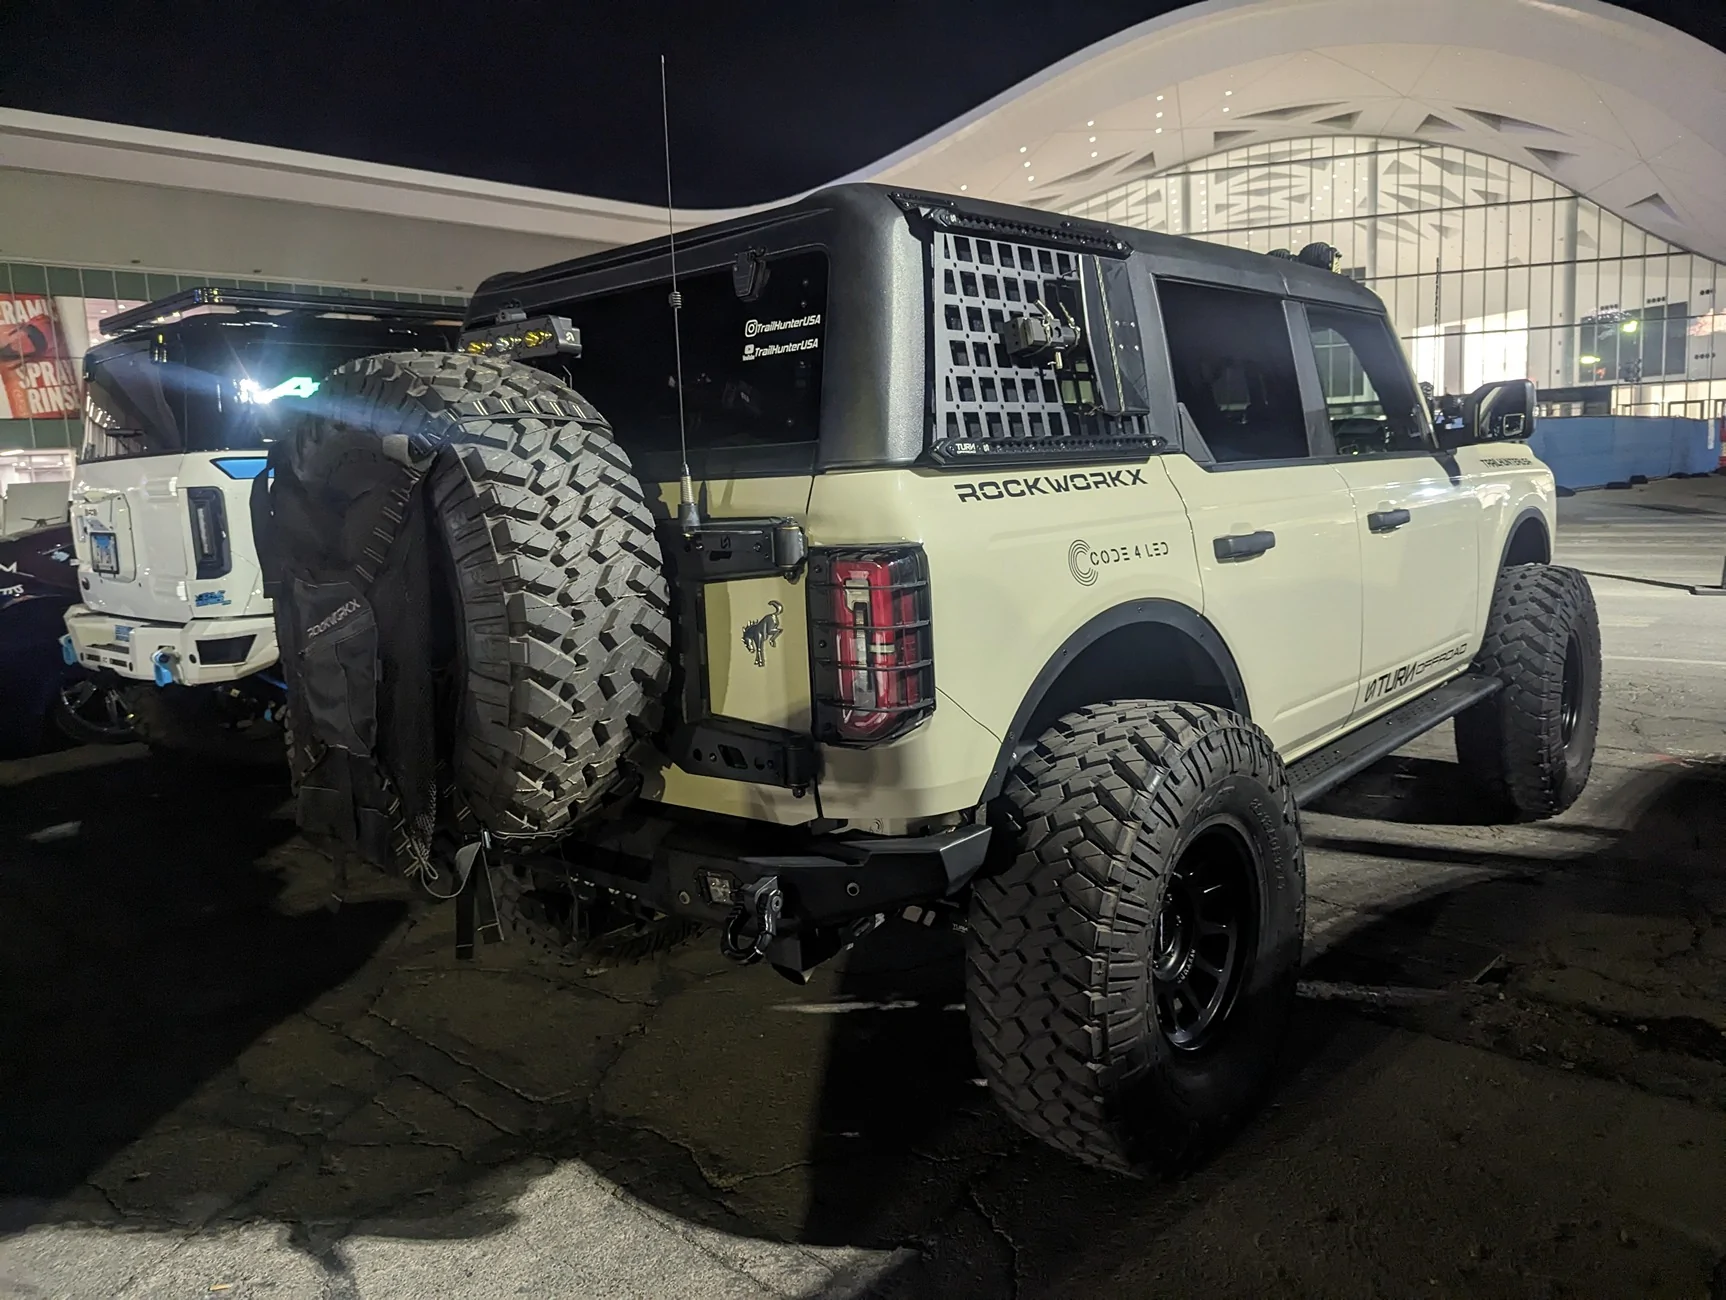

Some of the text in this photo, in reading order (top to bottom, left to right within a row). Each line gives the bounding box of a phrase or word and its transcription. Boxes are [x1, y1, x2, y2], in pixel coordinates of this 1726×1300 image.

[757, 314, 821, 333] TrailHunterUSA
[754, 338, 818, 357] TrailHunterUSA
[16, 361, 75, 389] SPRAY
[28, 384, 81, 414] RINSE
[954, 469, 1148, 503] ROCKWORKX
[1090, 541, 1169, 566] CODE 4 LED
